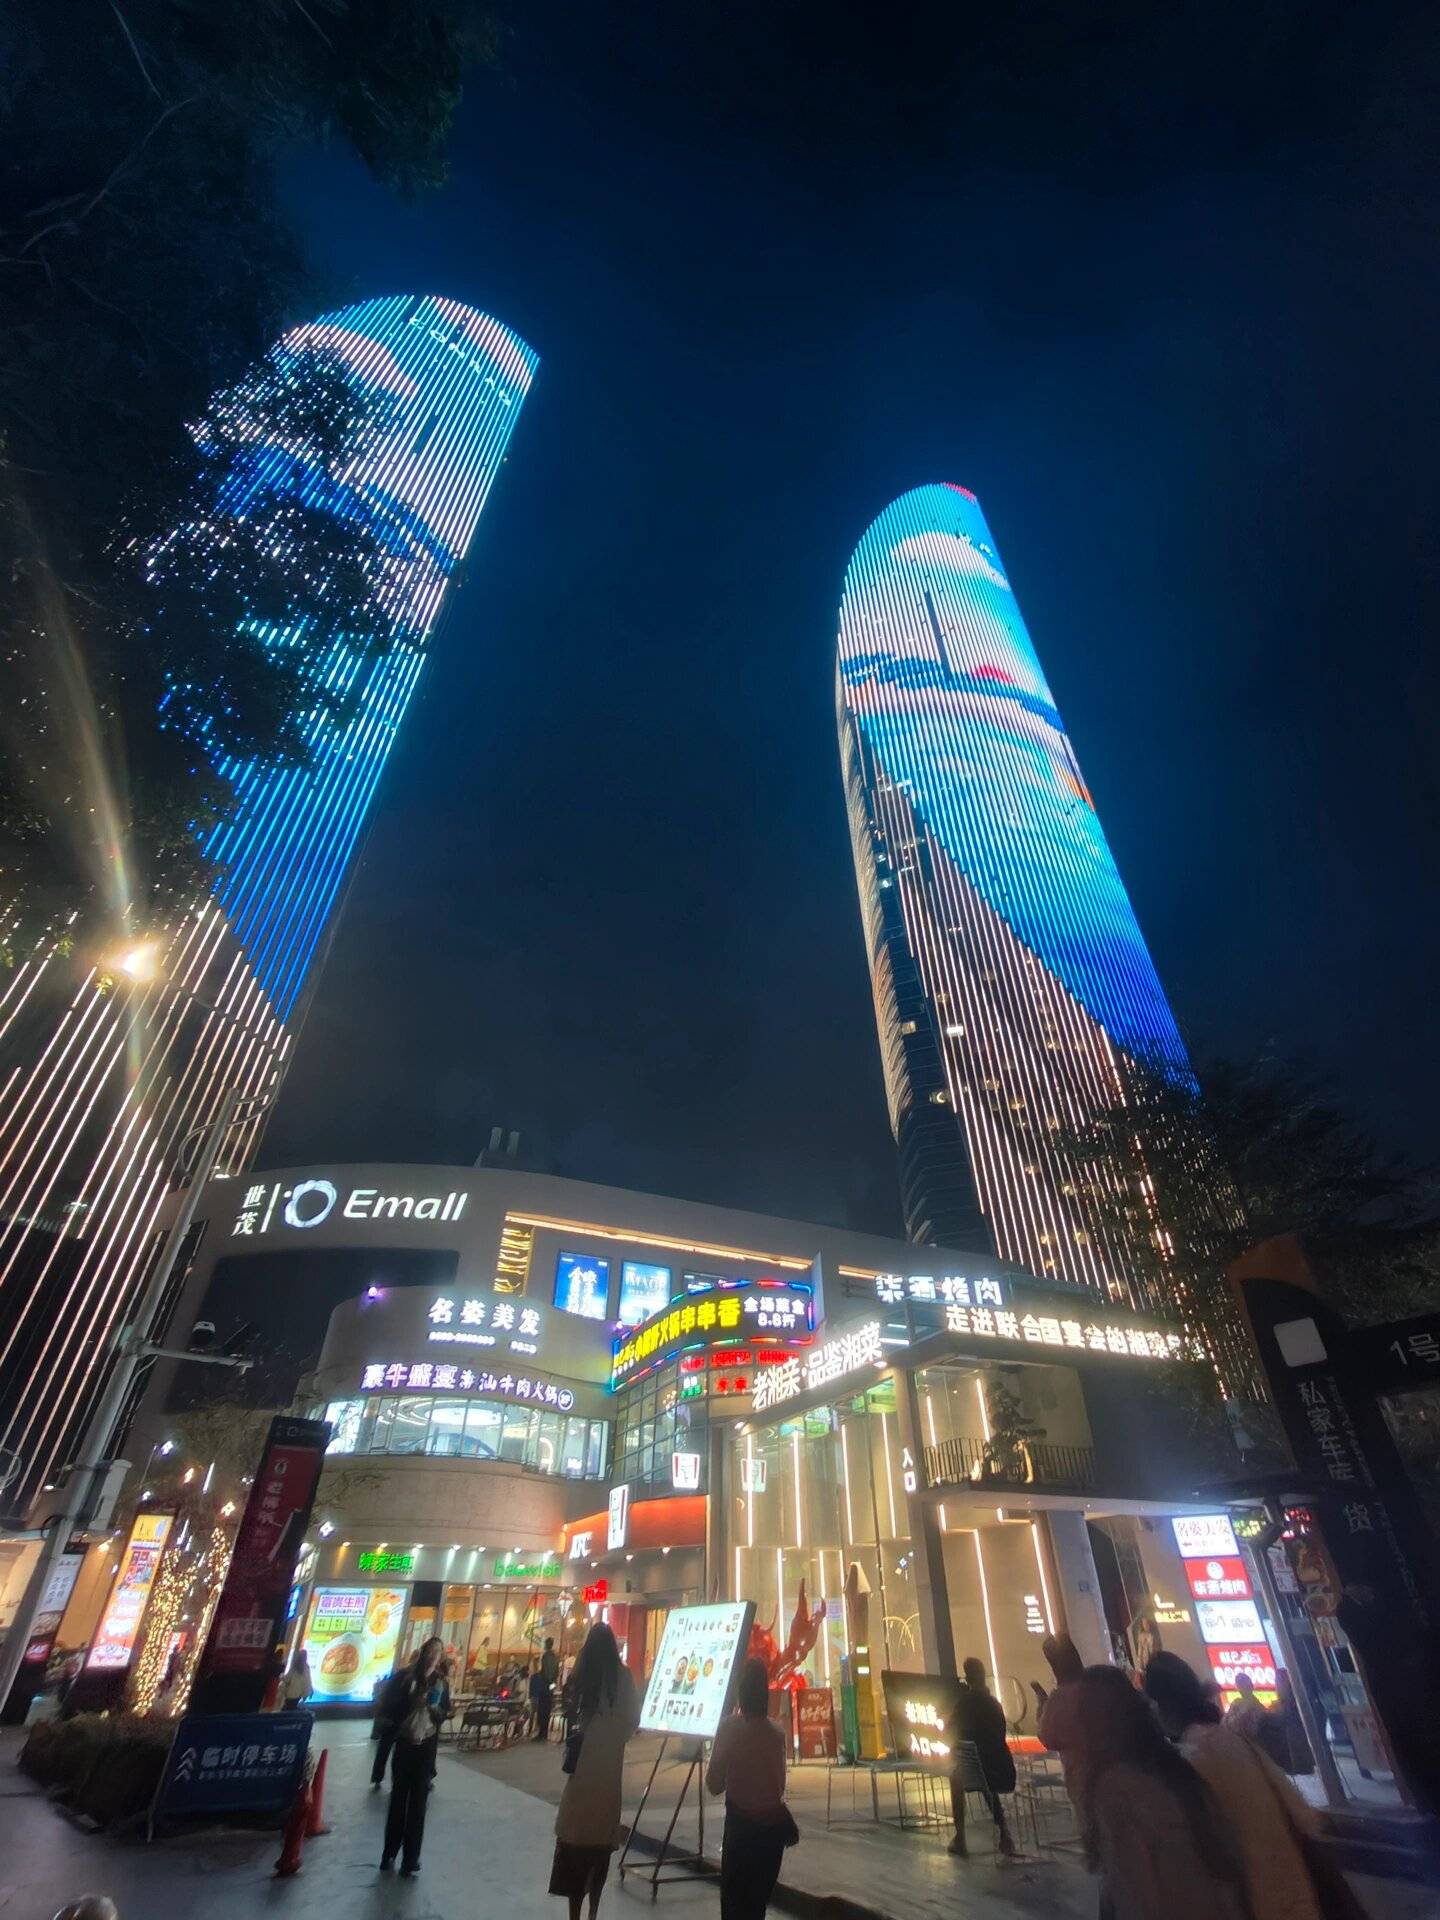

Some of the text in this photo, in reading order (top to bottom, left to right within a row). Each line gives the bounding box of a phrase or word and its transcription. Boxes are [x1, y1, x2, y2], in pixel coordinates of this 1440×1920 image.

[230, 1184, 266, 1237] 世茂
[342, 1189, 468, 1221] Emall
[428, 1297, 541, 1336] 名姿美发
[902, 1447, 917, 1492] 入口
[201, 1743, 298, 1768] 临时停车场
[910, 1733, 931, 1757] 入口
